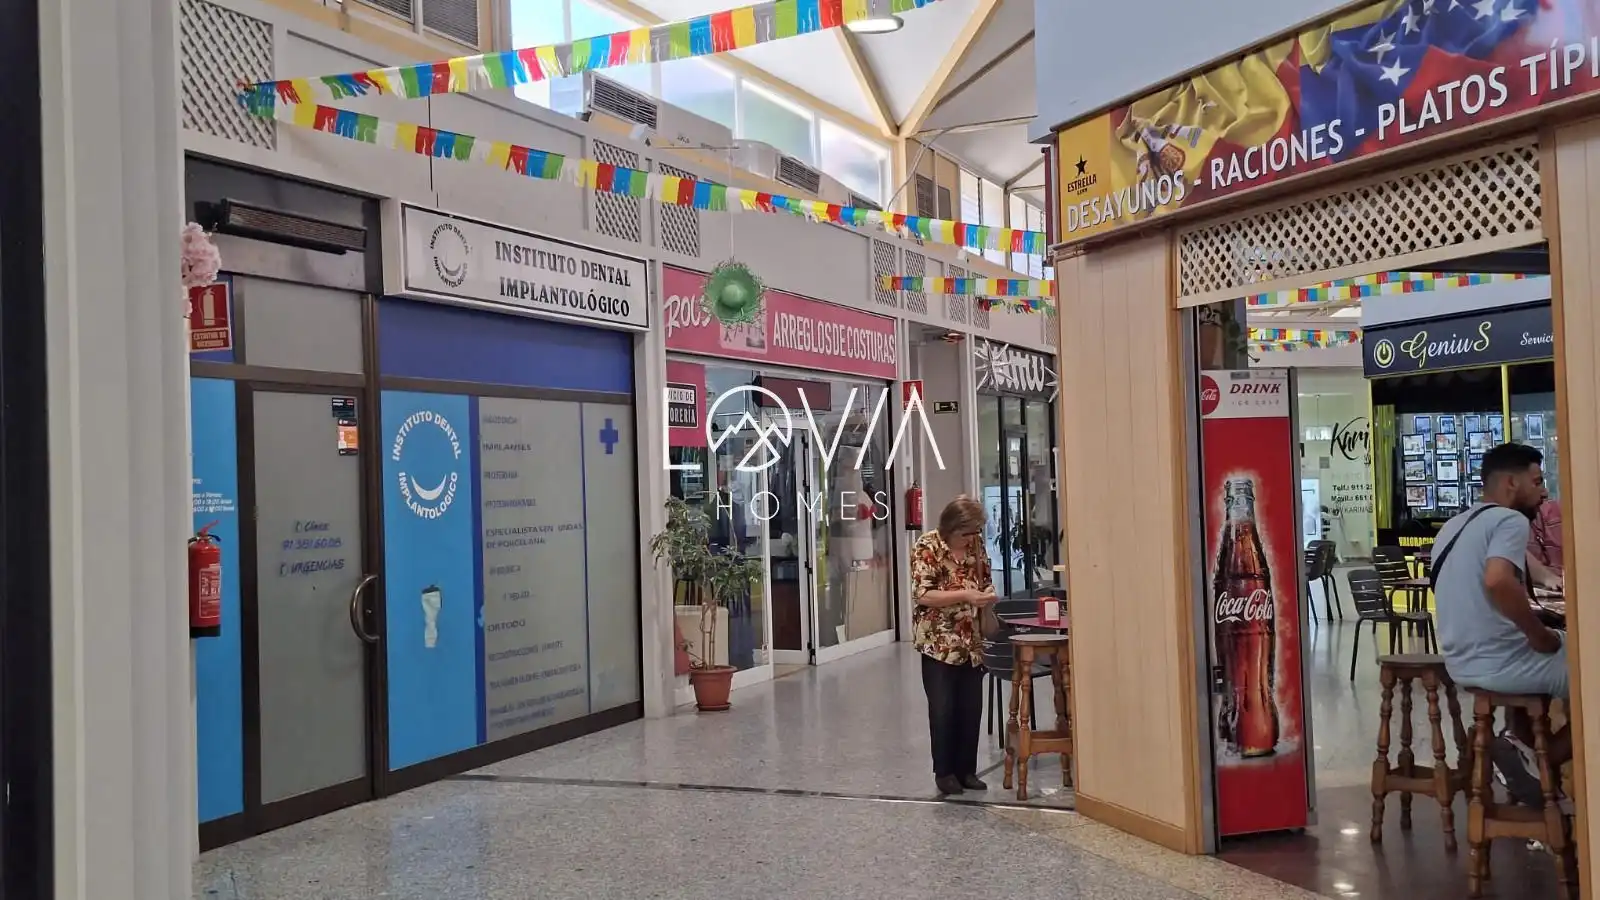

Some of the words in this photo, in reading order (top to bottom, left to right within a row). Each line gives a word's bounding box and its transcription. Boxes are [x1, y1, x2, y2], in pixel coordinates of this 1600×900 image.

[1067, 170, 1185, 232] DESAYUNOS
[1211, 119, 1344, 190] RACIONES
[1378, 66, 1508, 140] PLATOS
[1520, 36, 1600, 96] TÍPI
[1067, 174, 1097, 193] ESTRELLA
[495, 240, 577, 276] INSTITUTO
[580, 259, 631, 287] DENTAL
[499, 276, 630, 317] IMPLANTOLÓGICO
[773, 311, 832, 356] ARREGLOS
[833, 324, 847, 357] DE
[847, 327, 897, 364] COSTURAS
[685, 391, 694, 402] DE
[1230, 383, 1281, 394] DRINK
[392, 411, 433, 461] INSTITUTO
[434, 413, 462, 460] DENTAL
[398, 472, 458, 519] IMPLANTOLOGICO
